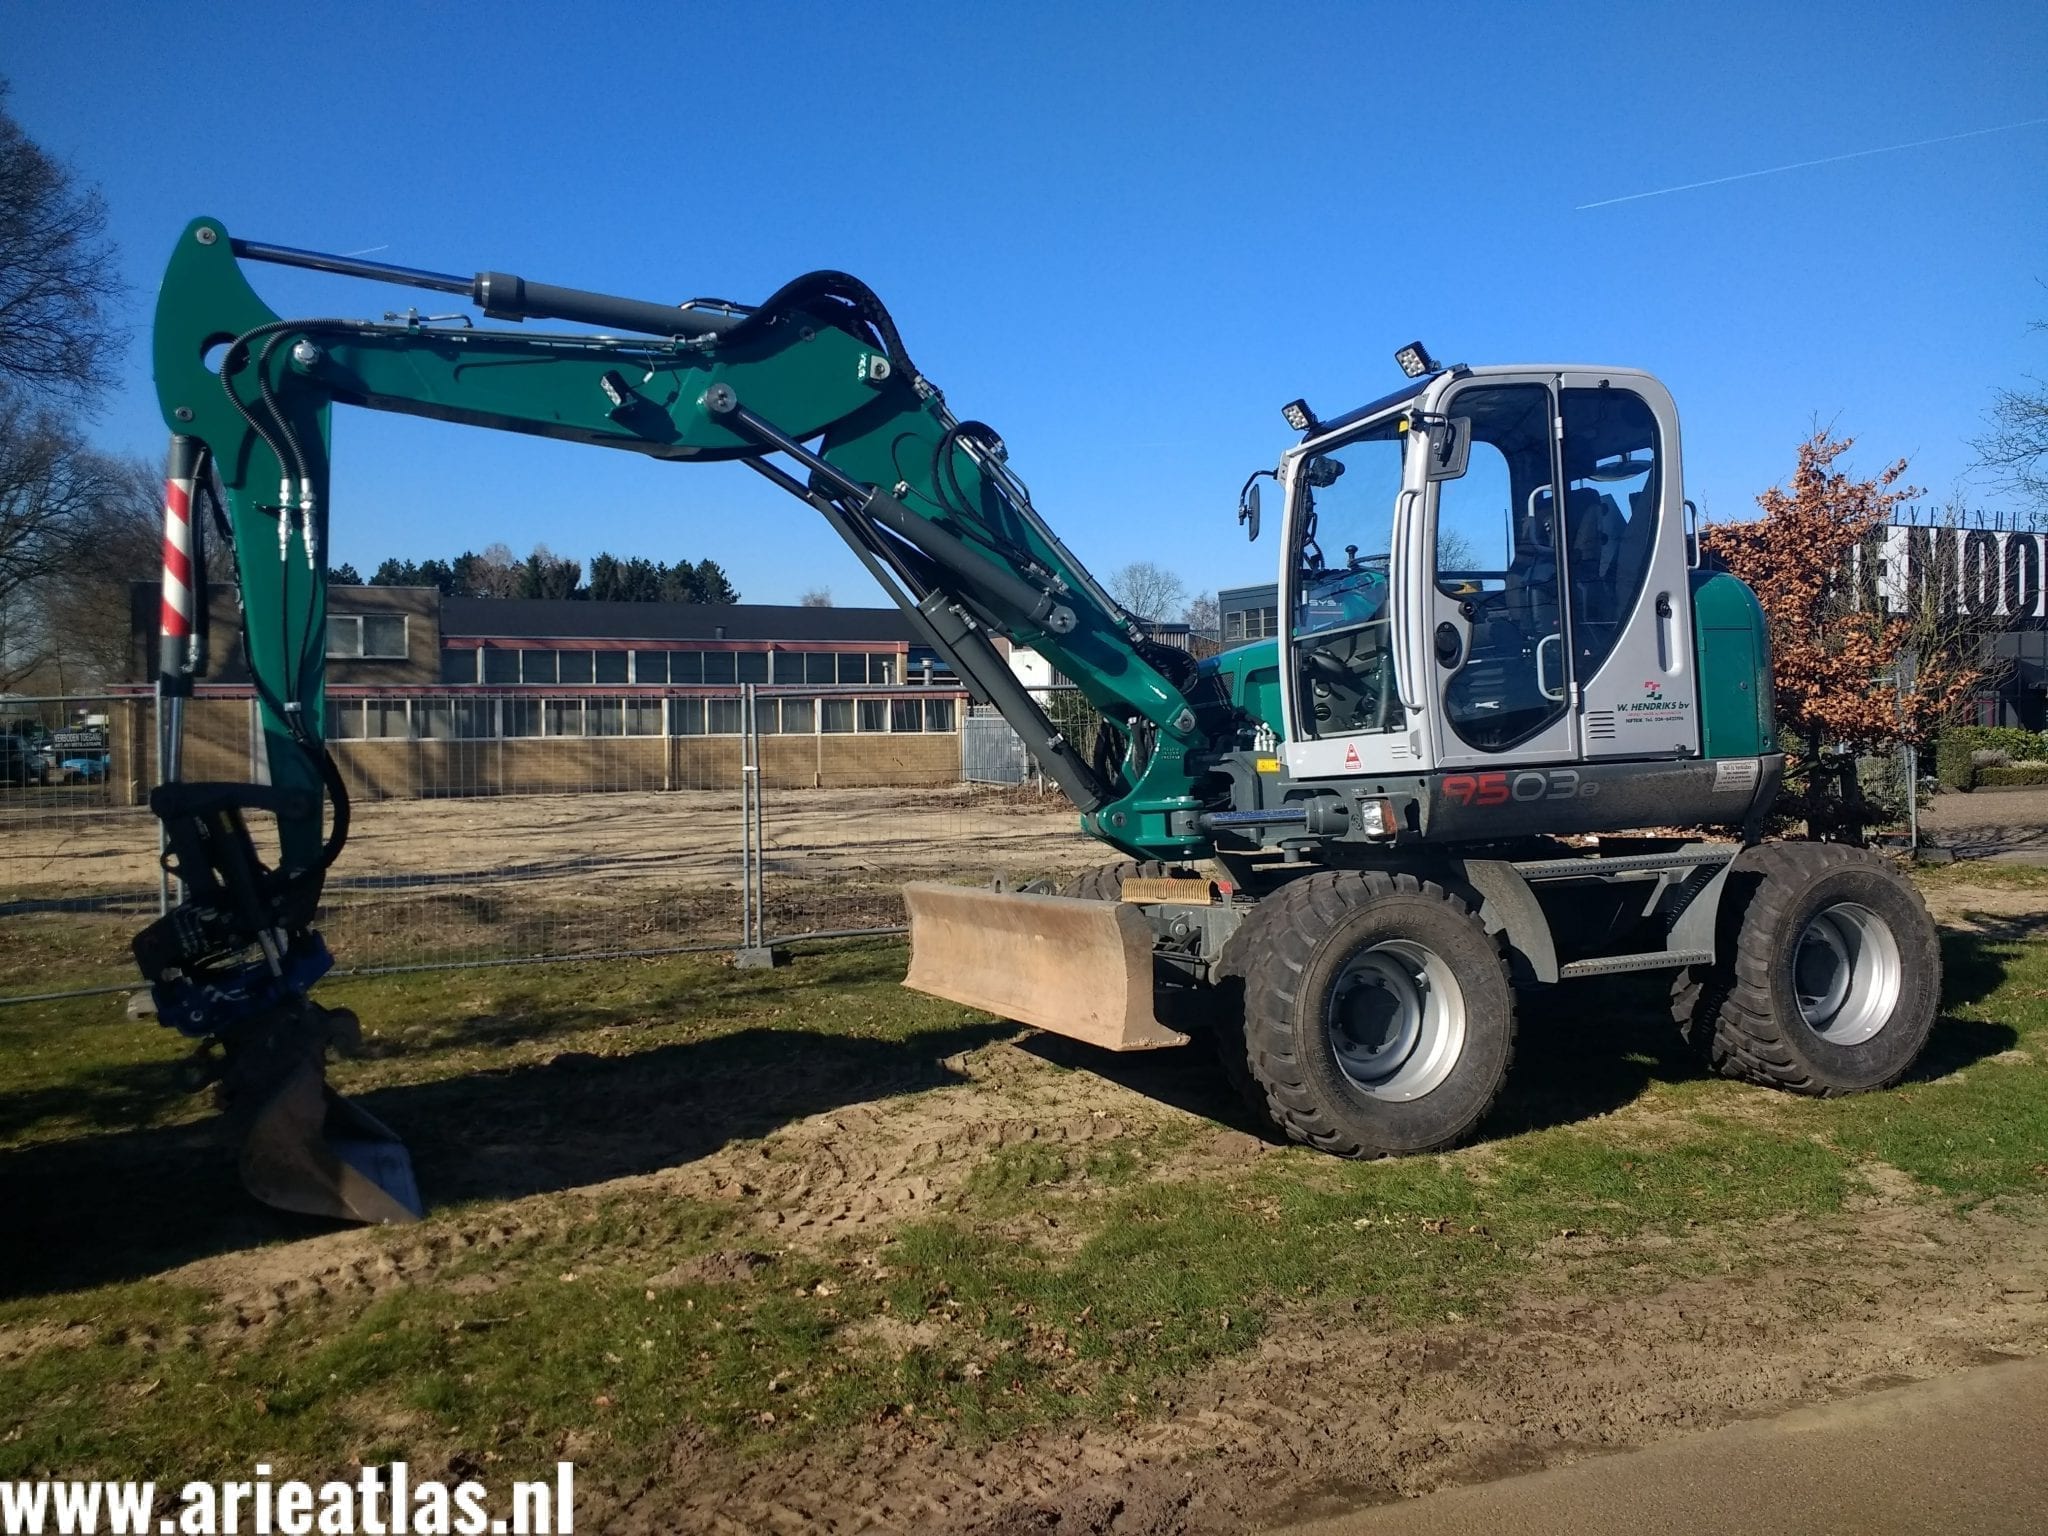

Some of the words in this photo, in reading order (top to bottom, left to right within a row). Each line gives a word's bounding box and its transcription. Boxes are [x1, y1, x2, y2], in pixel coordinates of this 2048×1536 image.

[1617, 703, 1628, 712] W.
[1631, 701, 1677, 711] HENDRIKS
[1678, 701, 1690, 709] bv
